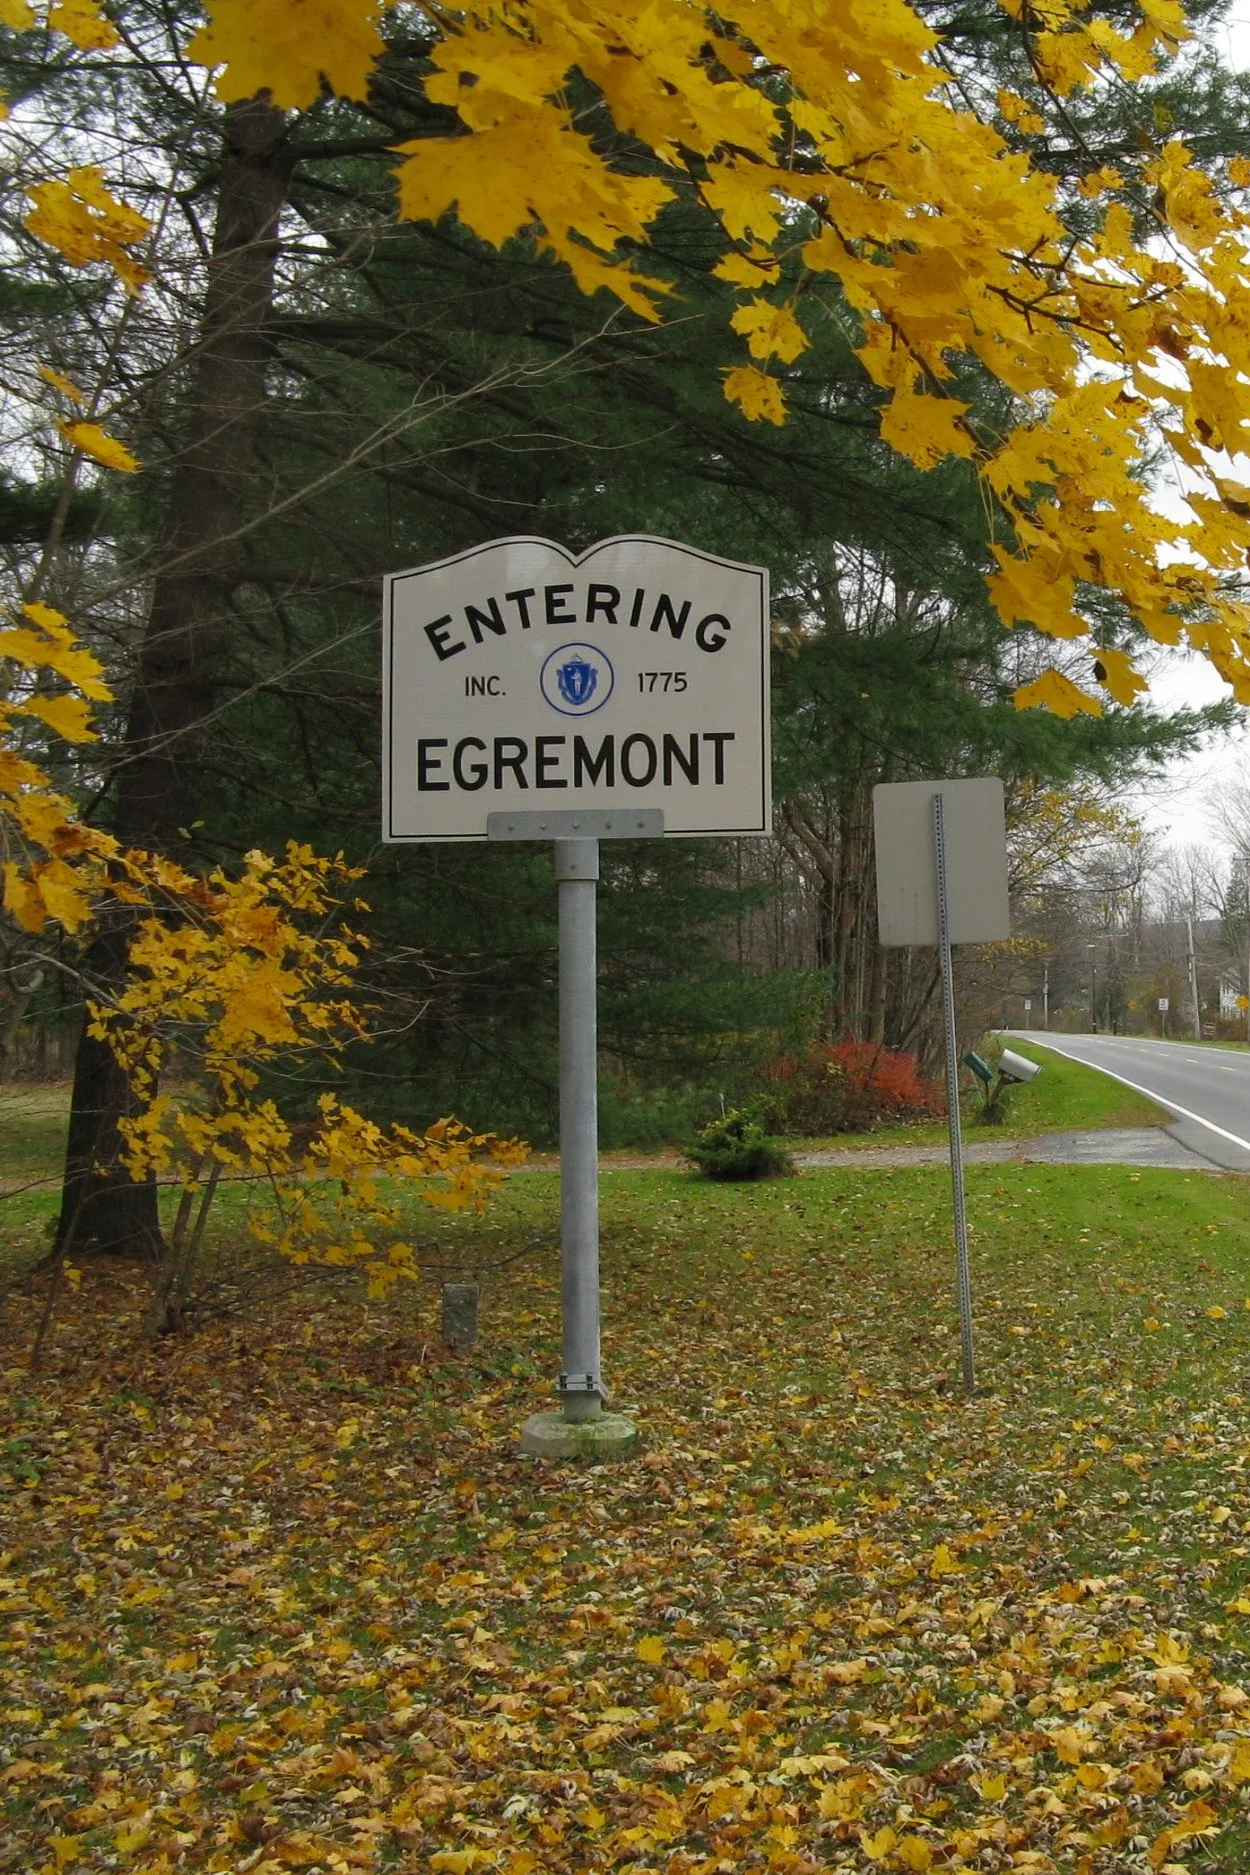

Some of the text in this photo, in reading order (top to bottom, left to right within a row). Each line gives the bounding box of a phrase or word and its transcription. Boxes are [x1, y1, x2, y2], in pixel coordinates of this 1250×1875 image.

[424, 583, 732, 662] ENTERING
[465, 671, 688, 697] INC. 1775
[417, 732, 736, 792] EGREMONT
